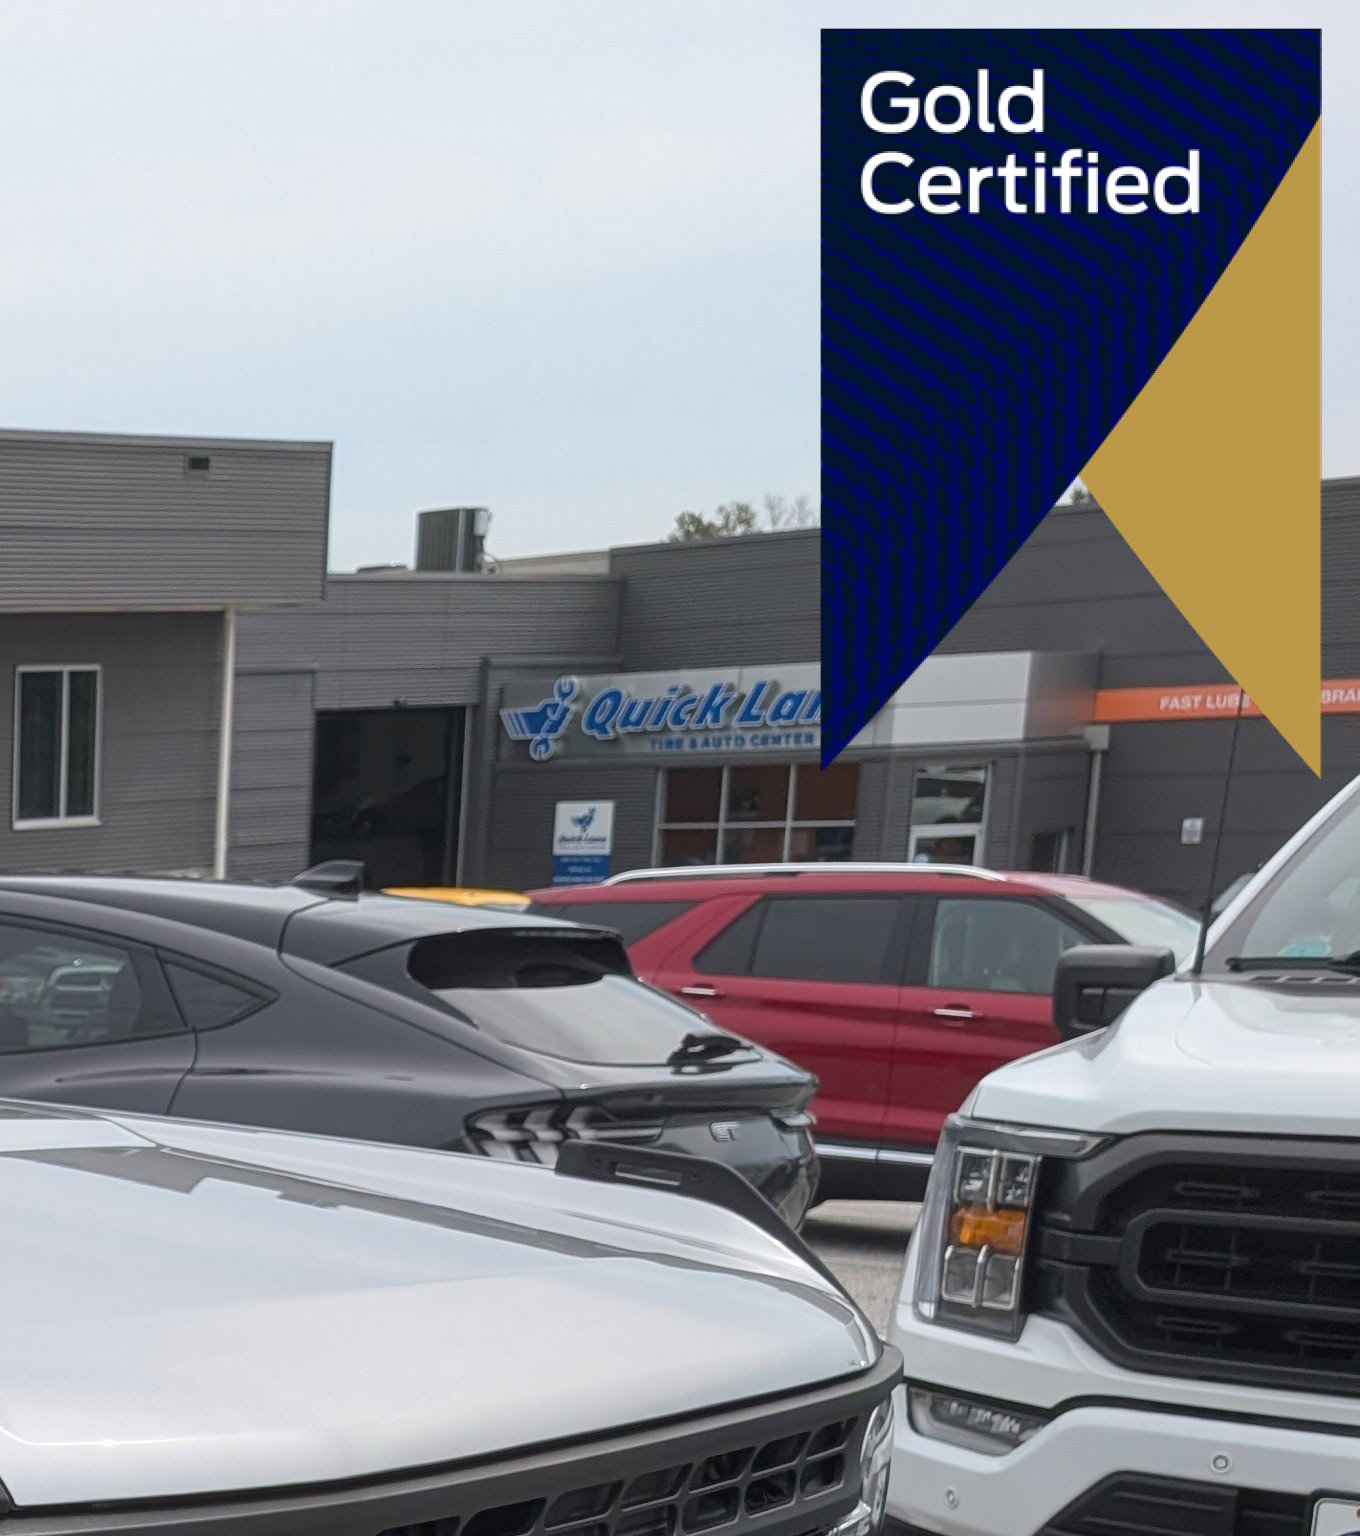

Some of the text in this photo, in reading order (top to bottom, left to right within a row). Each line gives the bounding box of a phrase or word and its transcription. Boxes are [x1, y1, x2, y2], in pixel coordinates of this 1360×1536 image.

[582, 682, 737, 740] Quick
[1159, 695, 1203, 710] FAST
[650, 738, 684, 750] TIRE
[701, 735, 745, 749] AUTO
[749, 731, 815, 747] CENTER
